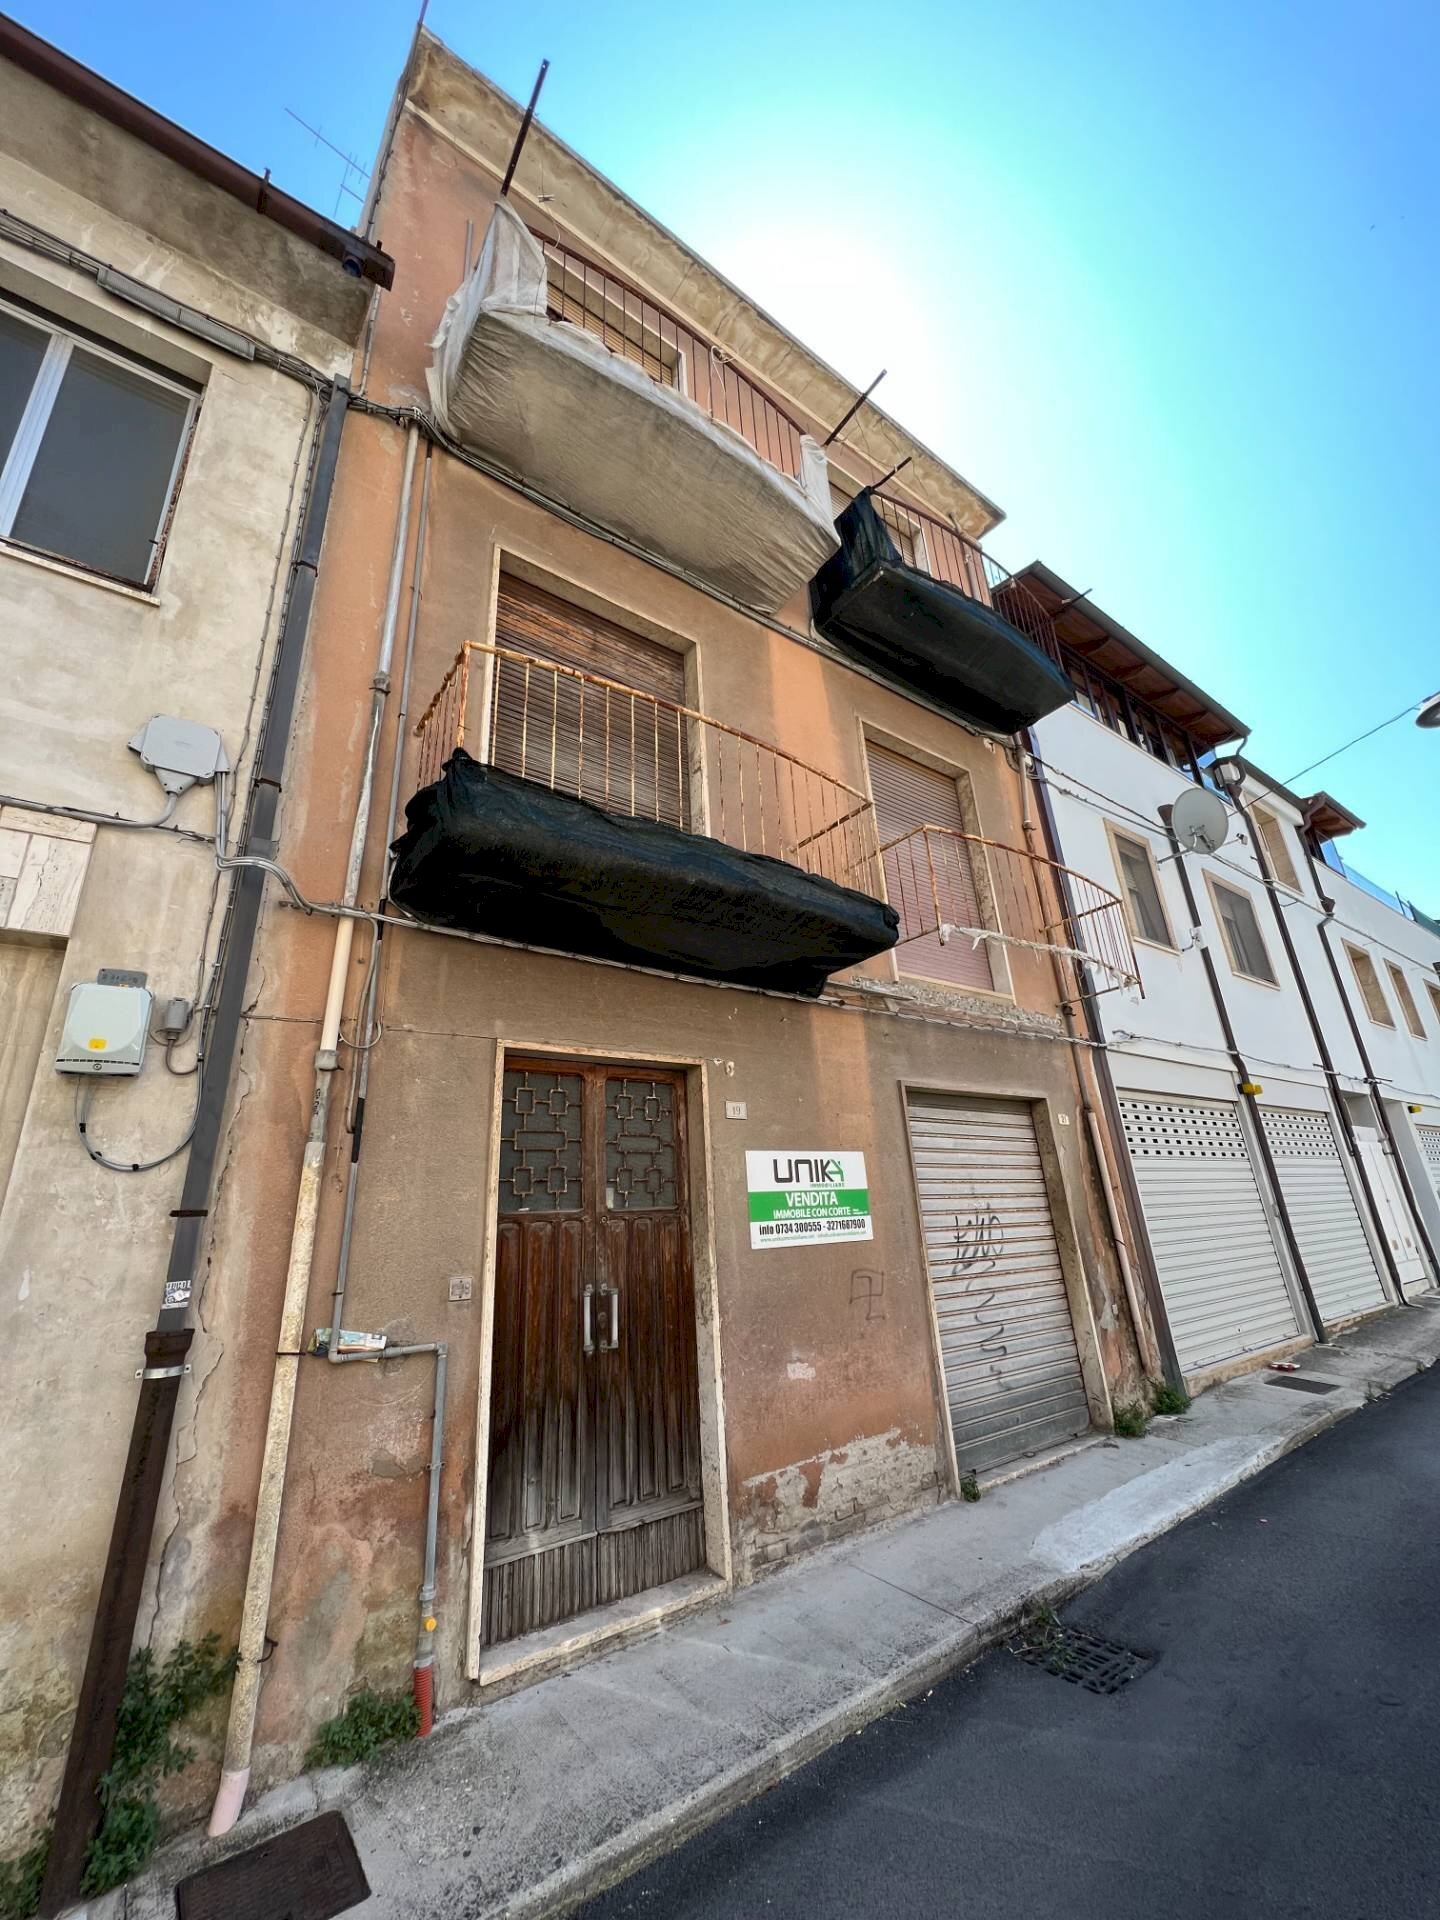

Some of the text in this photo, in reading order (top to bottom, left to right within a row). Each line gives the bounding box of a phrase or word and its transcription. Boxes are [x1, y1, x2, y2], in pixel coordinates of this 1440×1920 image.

[785, 1192, 838, 1207] VENDITA
[773, 1208, 811, 1219] IMMOBILE
[811, 1207, 828, 1217] CON
[828, 1206, 851, 1216] CORTE
[775, 1222, 793, 1233] 0734
[794, 1220, 822, 1232] 300555
[826, 1218, 865, 1231] 3271687900
